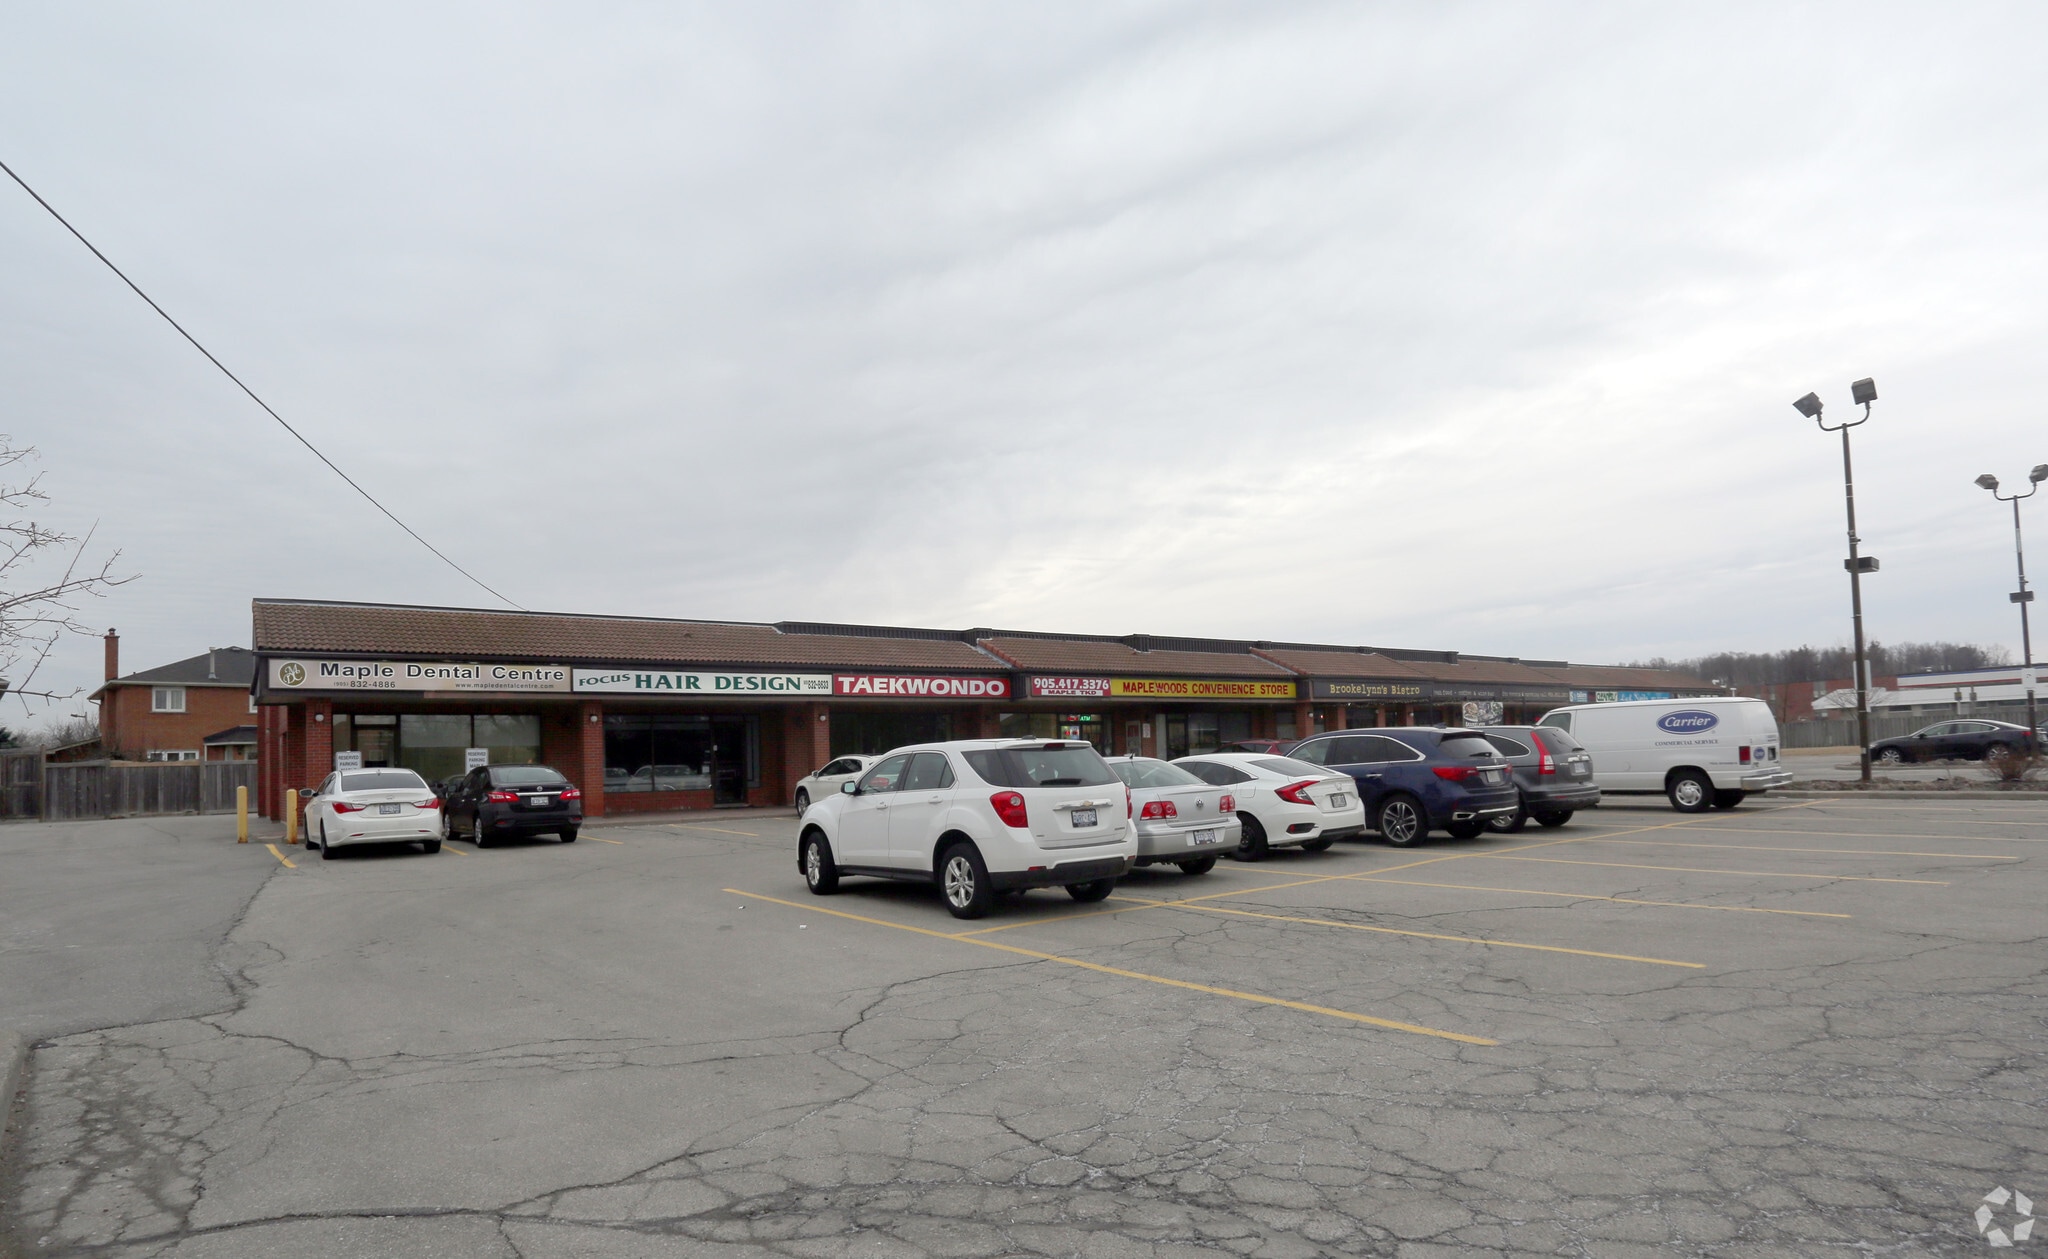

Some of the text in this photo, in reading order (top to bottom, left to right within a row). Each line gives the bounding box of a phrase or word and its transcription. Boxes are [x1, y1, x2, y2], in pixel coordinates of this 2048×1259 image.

[320, 662, 564, 681] Maple Dental Centre
[579, 674, 801, 691] FOCUS HAIR DESIGN
[838, 676, 1005, 696] TAEKWONDO
[1034, 678, 1109, 690] 905.417.3376
[1122, 681, 1289, 695] MAPLEWOODS CONVENIENCE STORE
[1329, 684, 1420, 696] Brookelynn's Bistro
[1665, 716, 1711, 728] Carrier
